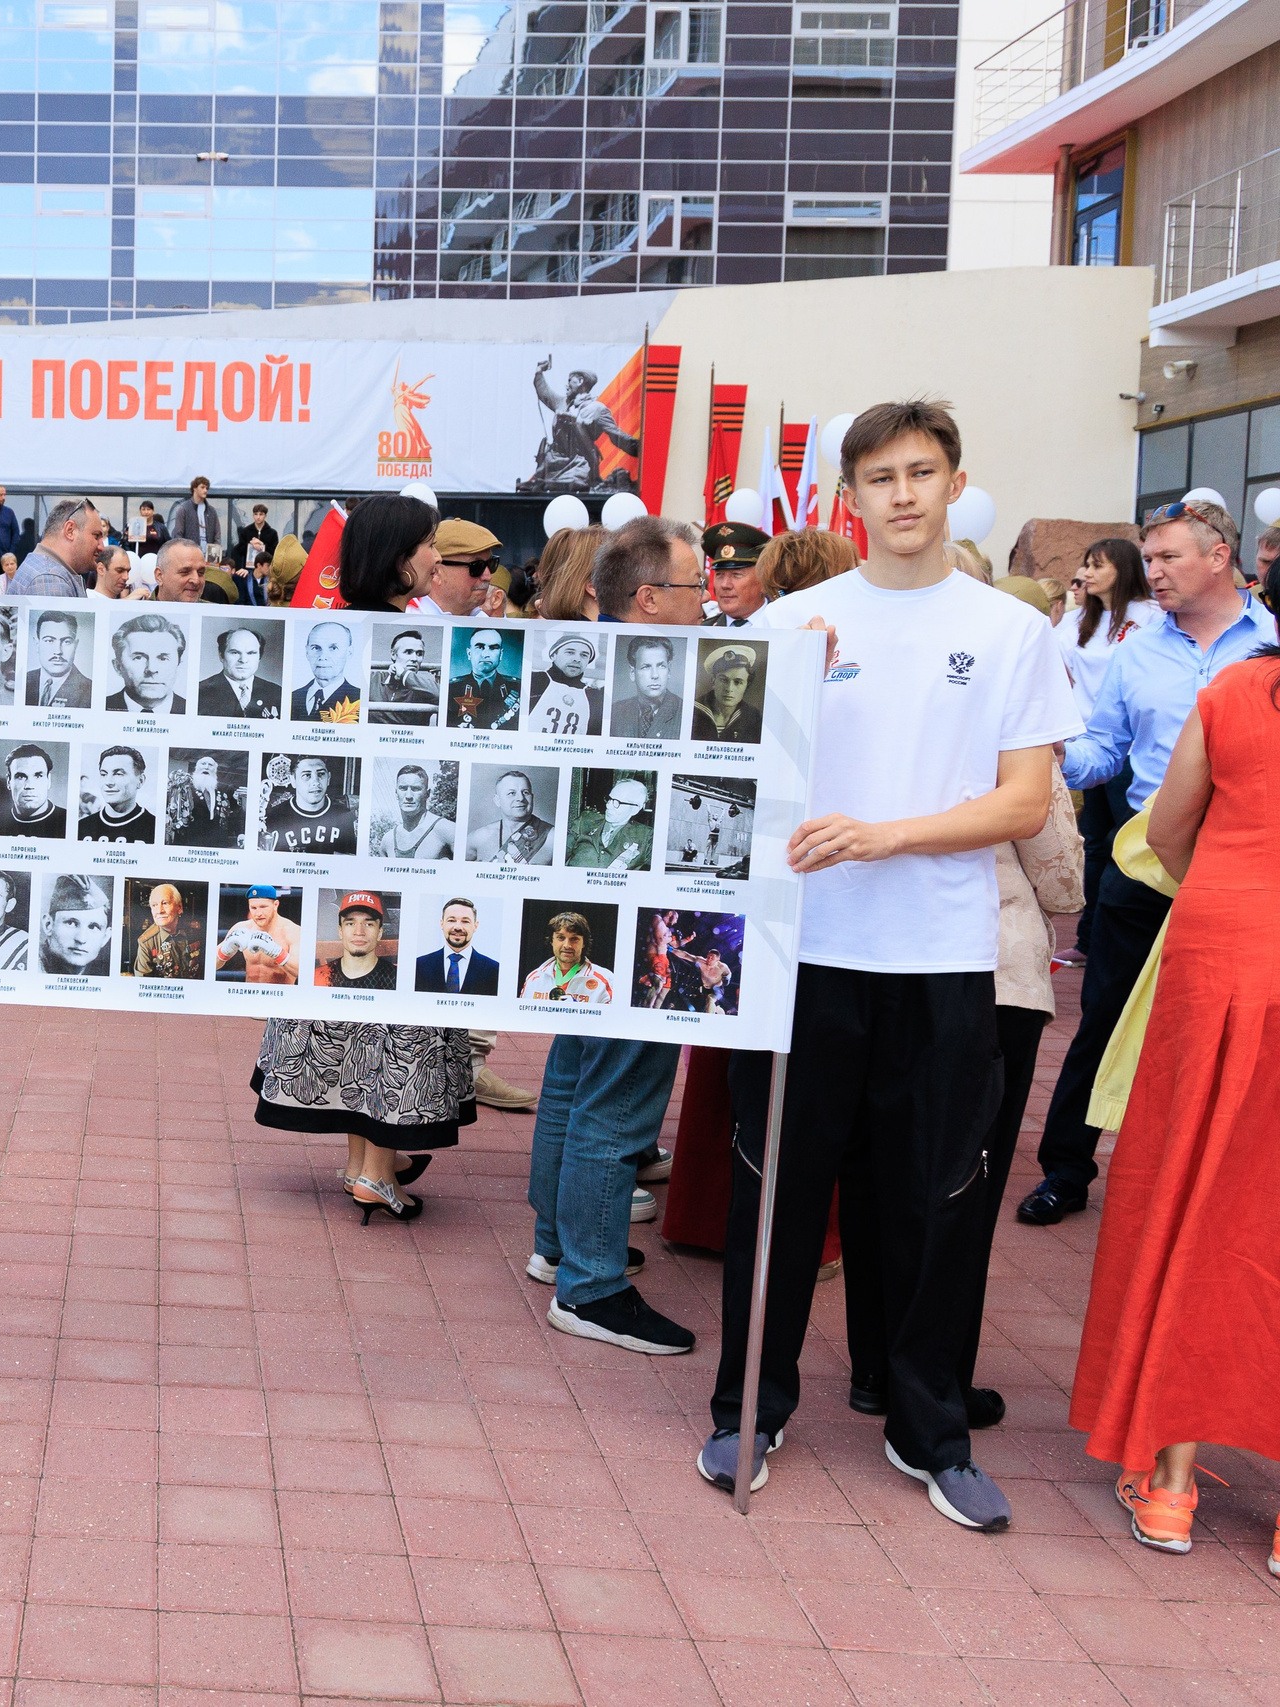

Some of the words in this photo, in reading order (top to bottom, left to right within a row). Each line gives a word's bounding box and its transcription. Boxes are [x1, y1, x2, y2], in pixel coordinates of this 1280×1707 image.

[32, 354, 311, 432] ПОБЕДОЙ!
[378, 430, 408, 458] 80
[377, 463, 432, 479] ПОБЕДА!
[542, 707, 580, 735] 38
[285, 826, 340, 846] СССР
